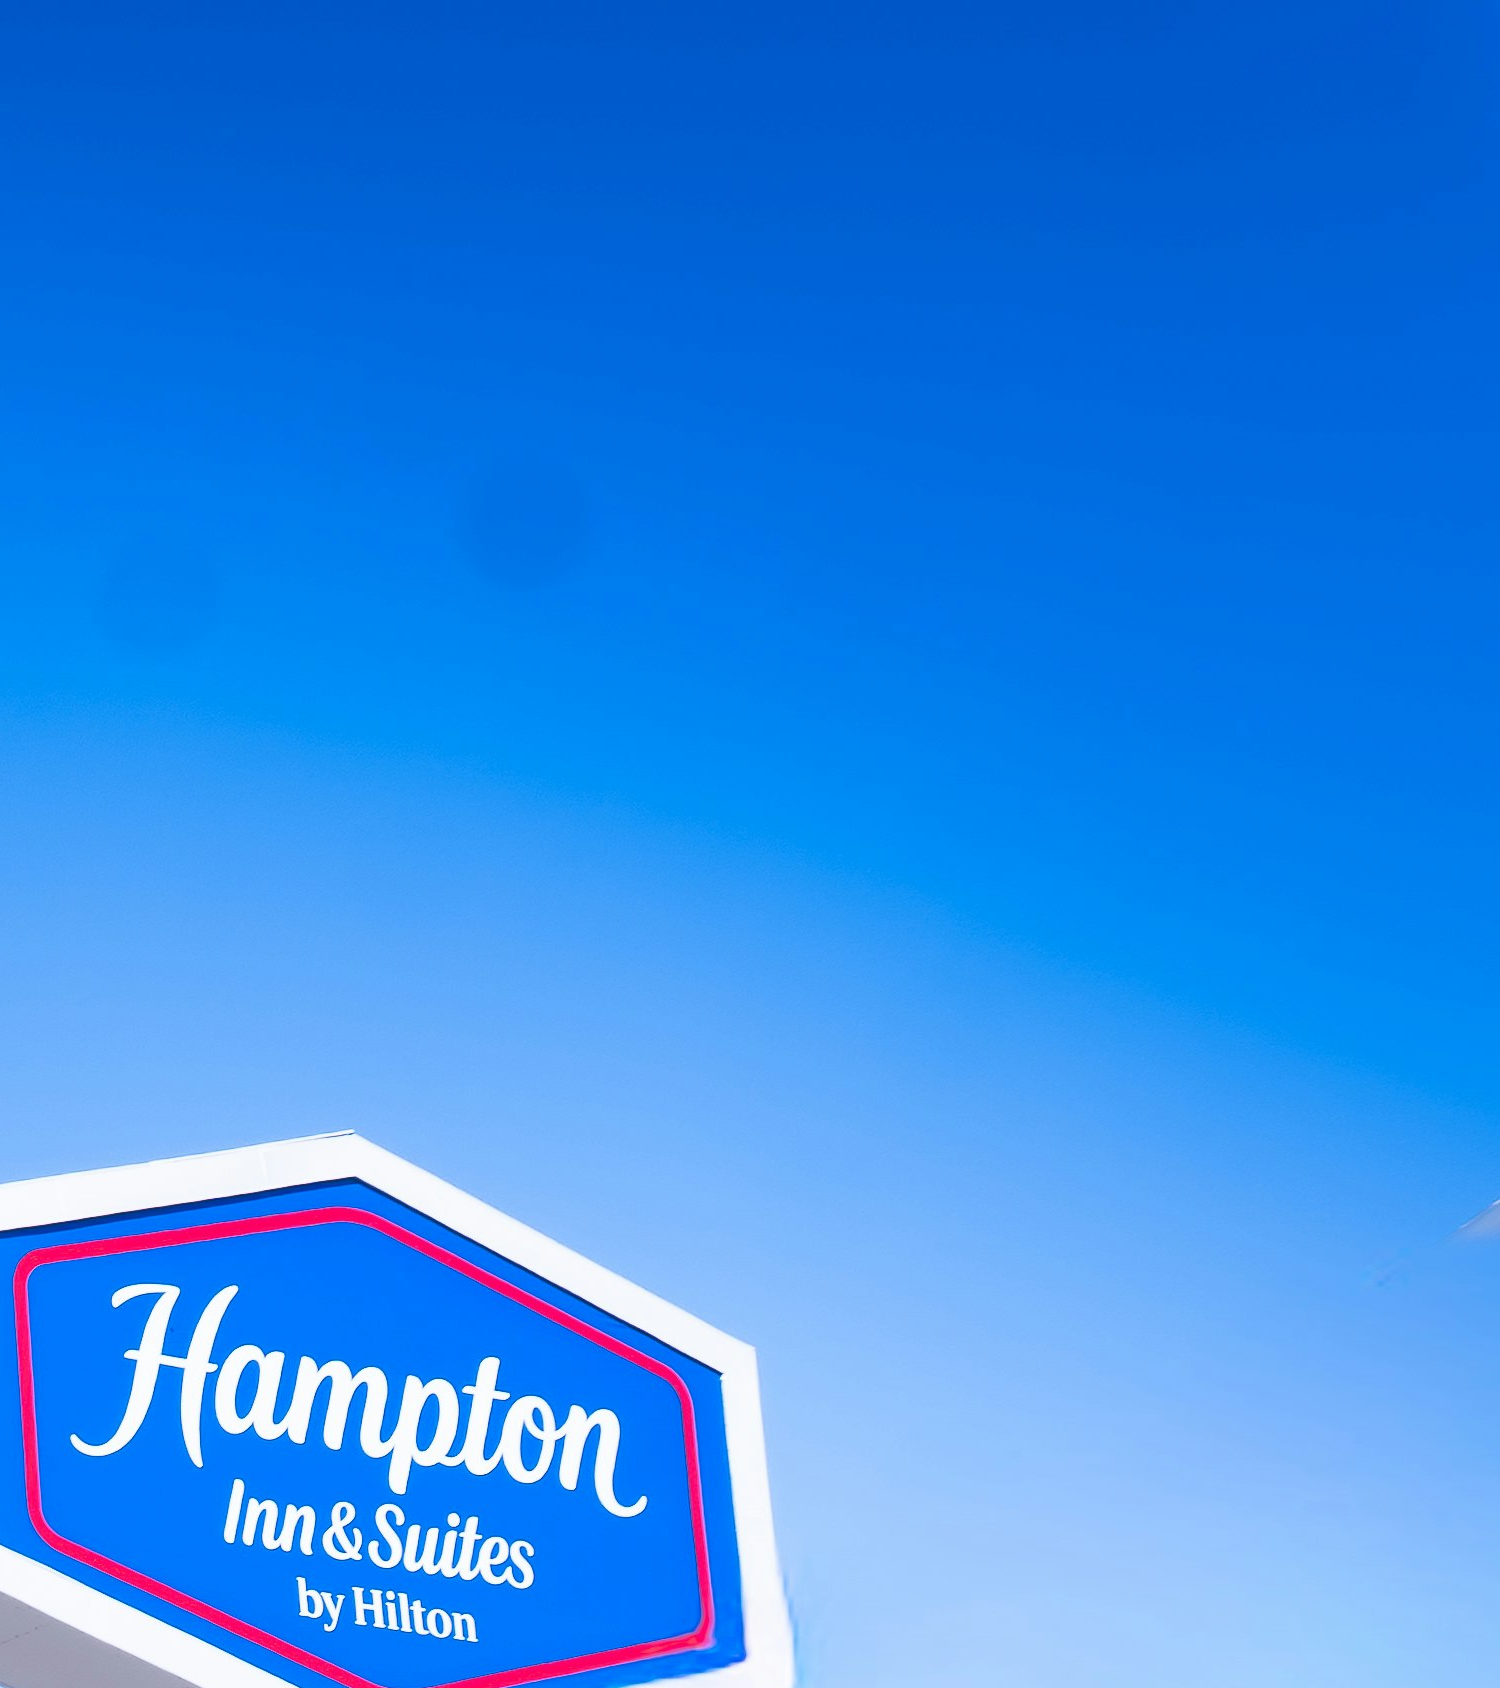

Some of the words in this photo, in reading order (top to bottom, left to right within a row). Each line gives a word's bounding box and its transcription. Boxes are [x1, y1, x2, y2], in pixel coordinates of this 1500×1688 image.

[70, 1283, 648, 1518] Hampton
[223, 1478, 316, 1556] Inn
[322, 1501, 363, 1561] &
[367, 1503, 535, 1590] Suites
[297, 1577, 346, 1632] by
[352, 1586, 479, 1643] Hilton
